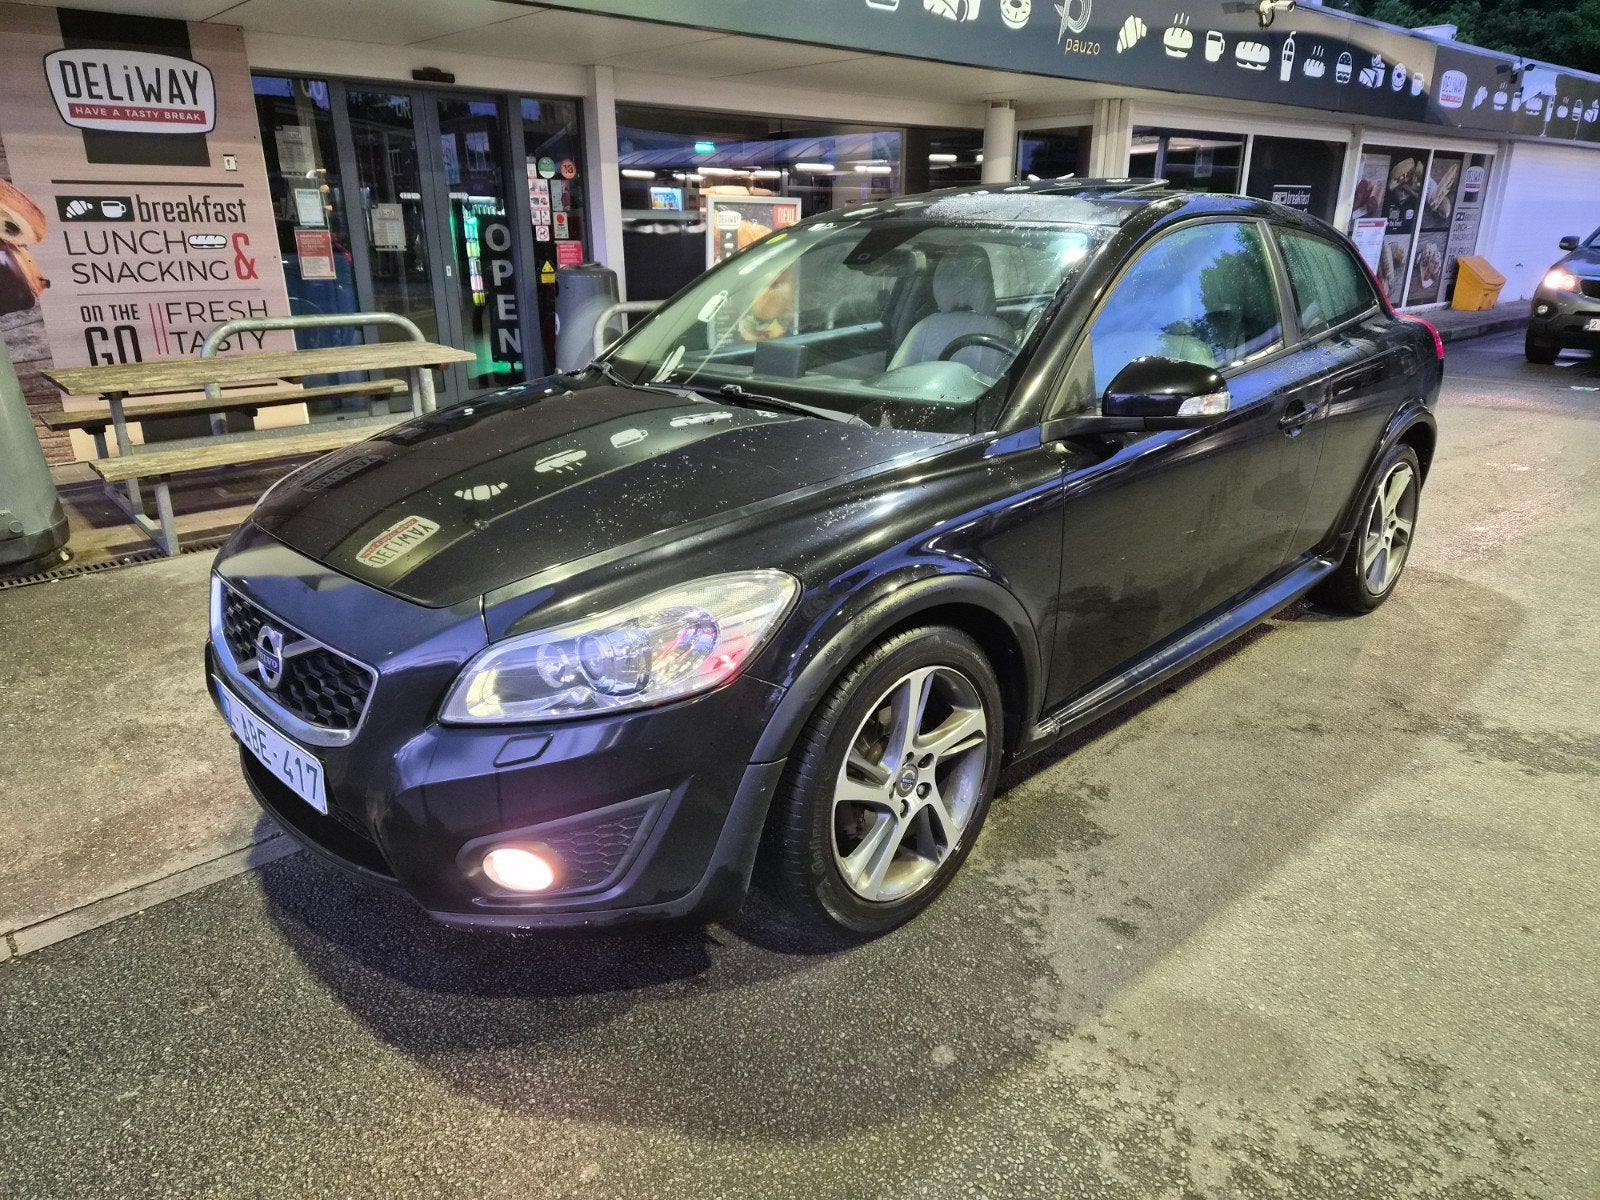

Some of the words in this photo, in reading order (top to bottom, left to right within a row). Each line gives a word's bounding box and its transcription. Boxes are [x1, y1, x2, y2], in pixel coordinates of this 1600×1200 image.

[1065, 38, 1100, 55] pauzo
[75, 107, 107, 116] HAVE
[113, 109, 121, 117] A
[124, 109, 159, 119] TASTY
[164, 111, 201, 121] BREAK
[136, 194, 247, 223] breakfast
[63, 230, 188, 256] LUNCH
[231, 232, 259, 280] &
[71, 260, 230, 285] SNACKING
[485, 223, 522, 353] OPEN
[109, 303, 140, 321] THE
[165, 299, 268, 325] FRESH
